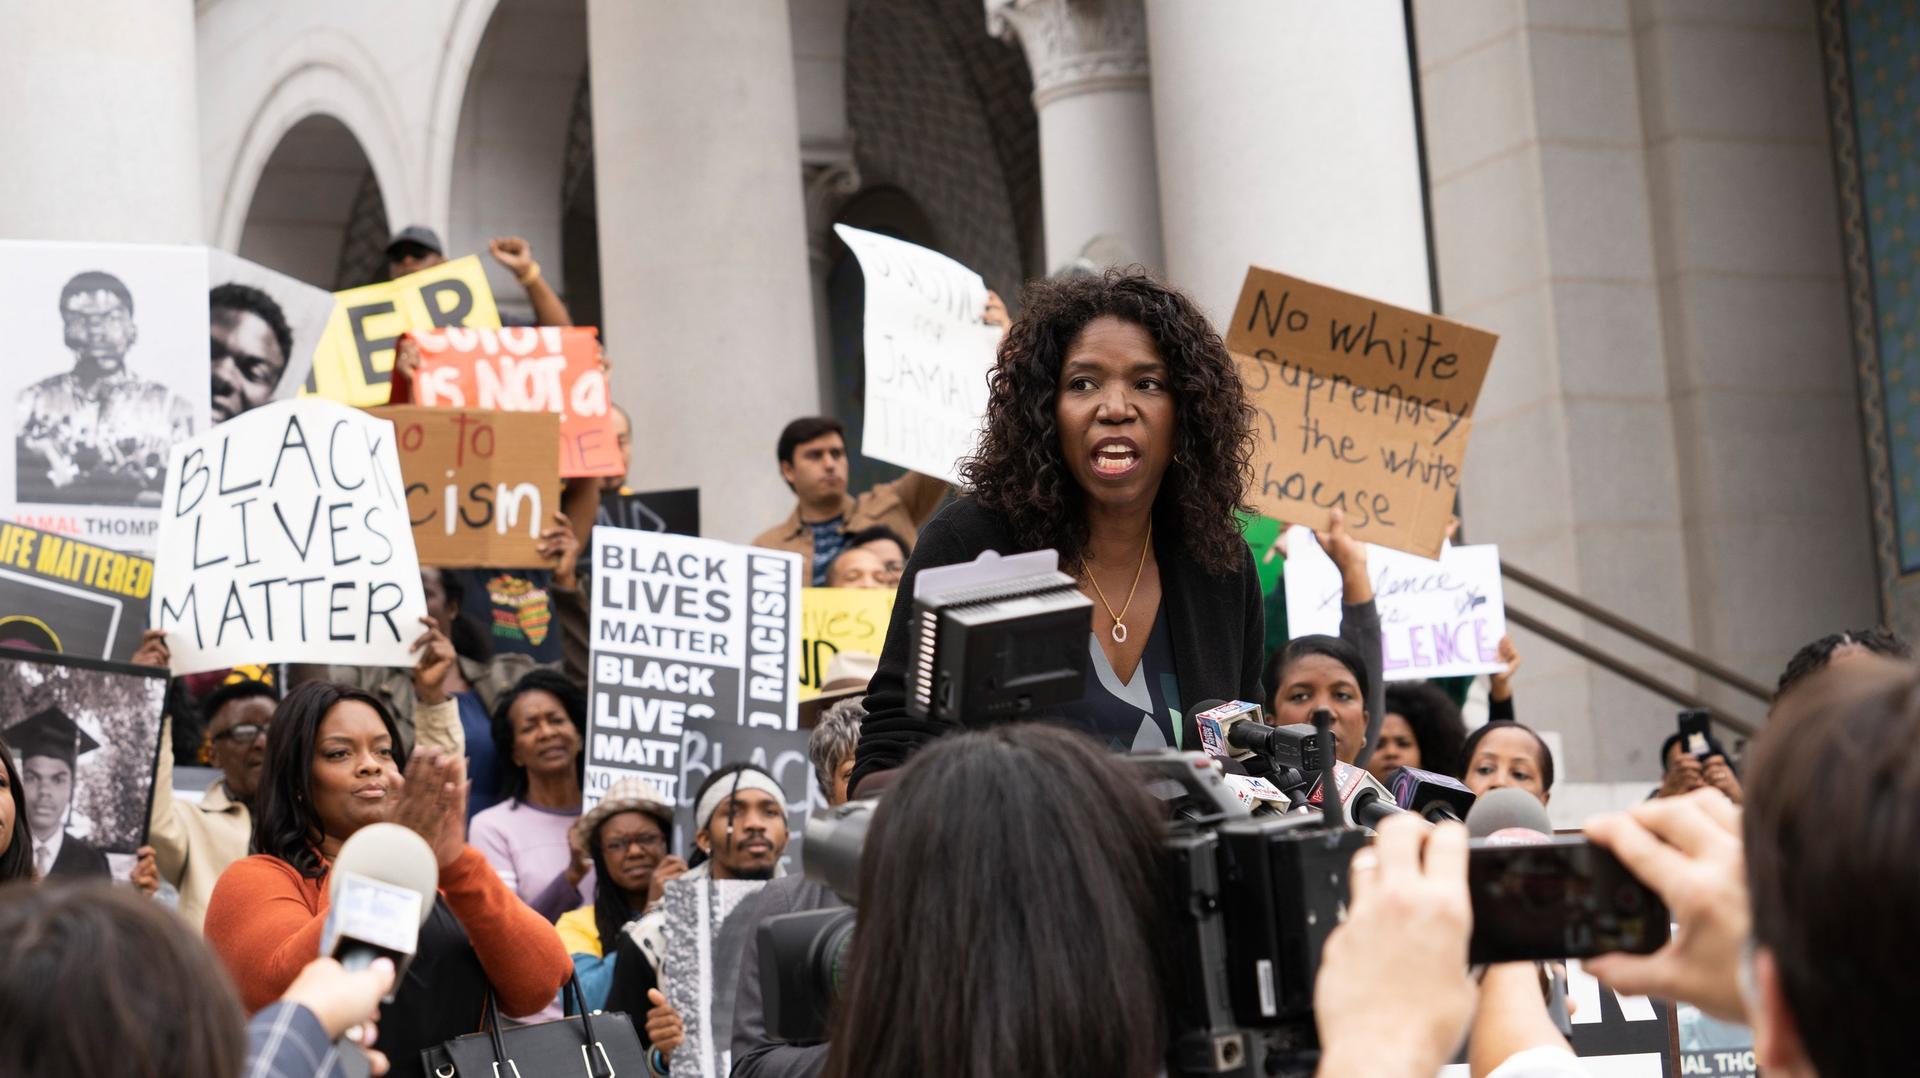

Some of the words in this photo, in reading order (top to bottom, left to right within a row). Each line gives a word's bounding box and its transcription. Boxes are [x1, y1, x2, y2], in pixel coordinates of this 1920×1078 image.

[302, 278, 474, 394] ER
[1247, 289, 1309, 338] No
[1330, 311, 1459, 380] white
[475, 355, 567, 413] NOT
[175, 413, 400, 518] BLACK
[1299, 415, 1368, 464] the
[1381, 441, 1459, 492] white
[405, 469, 543, 539] cism
[1262, 461, 1395, 529] house
[0, 523, 38, 570] IFE
[35, 534, 154, 599] MATTERED
[193, 495, 394, 571] LIVES
[601, 544, 728, 583] BLACK
[160, 576, 404, 650] MATTER
[601, 576, 732, 623] LIVES
[749, 556, 787, 703] RACISM
[599, 619, 729, 656] MATTER
[595, 654, 715, 697] BLACK
[595, 691, 716, 737] LIVE
[593, 732, 681, 769] MATT
